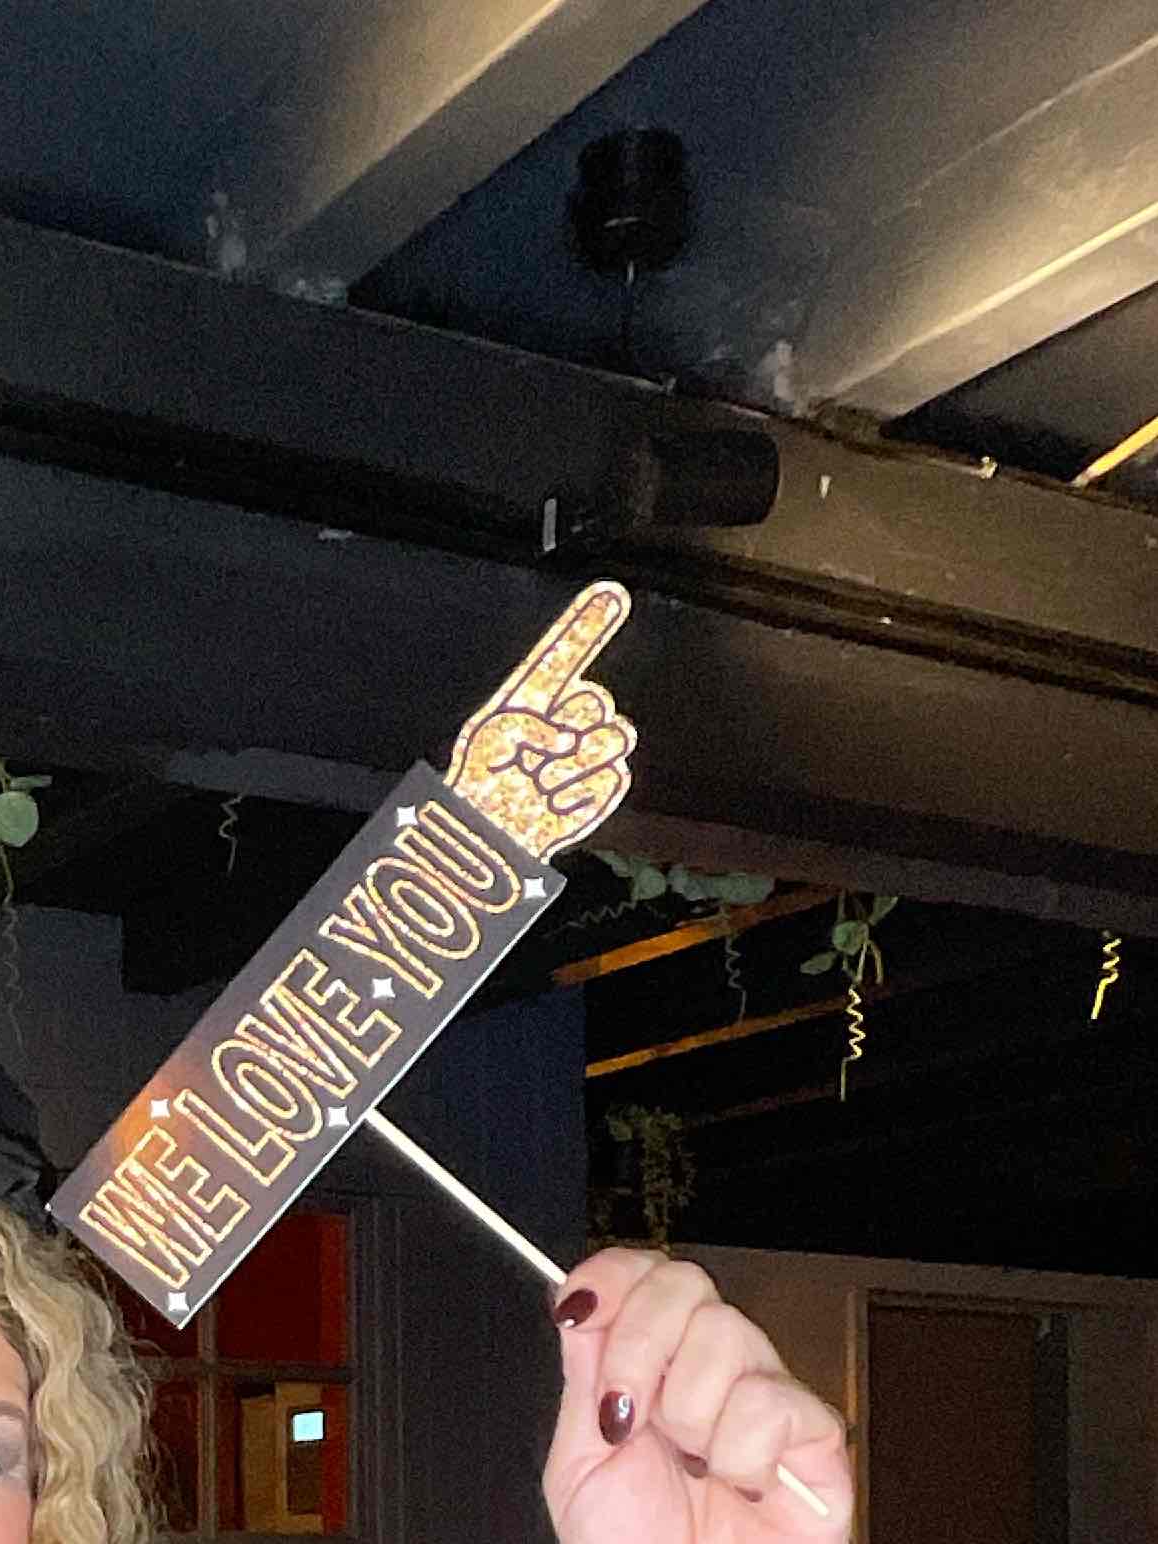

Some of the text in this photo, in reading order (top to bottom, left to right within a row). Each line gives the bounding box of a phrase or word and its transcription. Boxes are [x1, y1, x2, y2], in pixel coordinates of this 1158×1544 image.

[79, 801, 522, 1288] WE LOVE YOU
